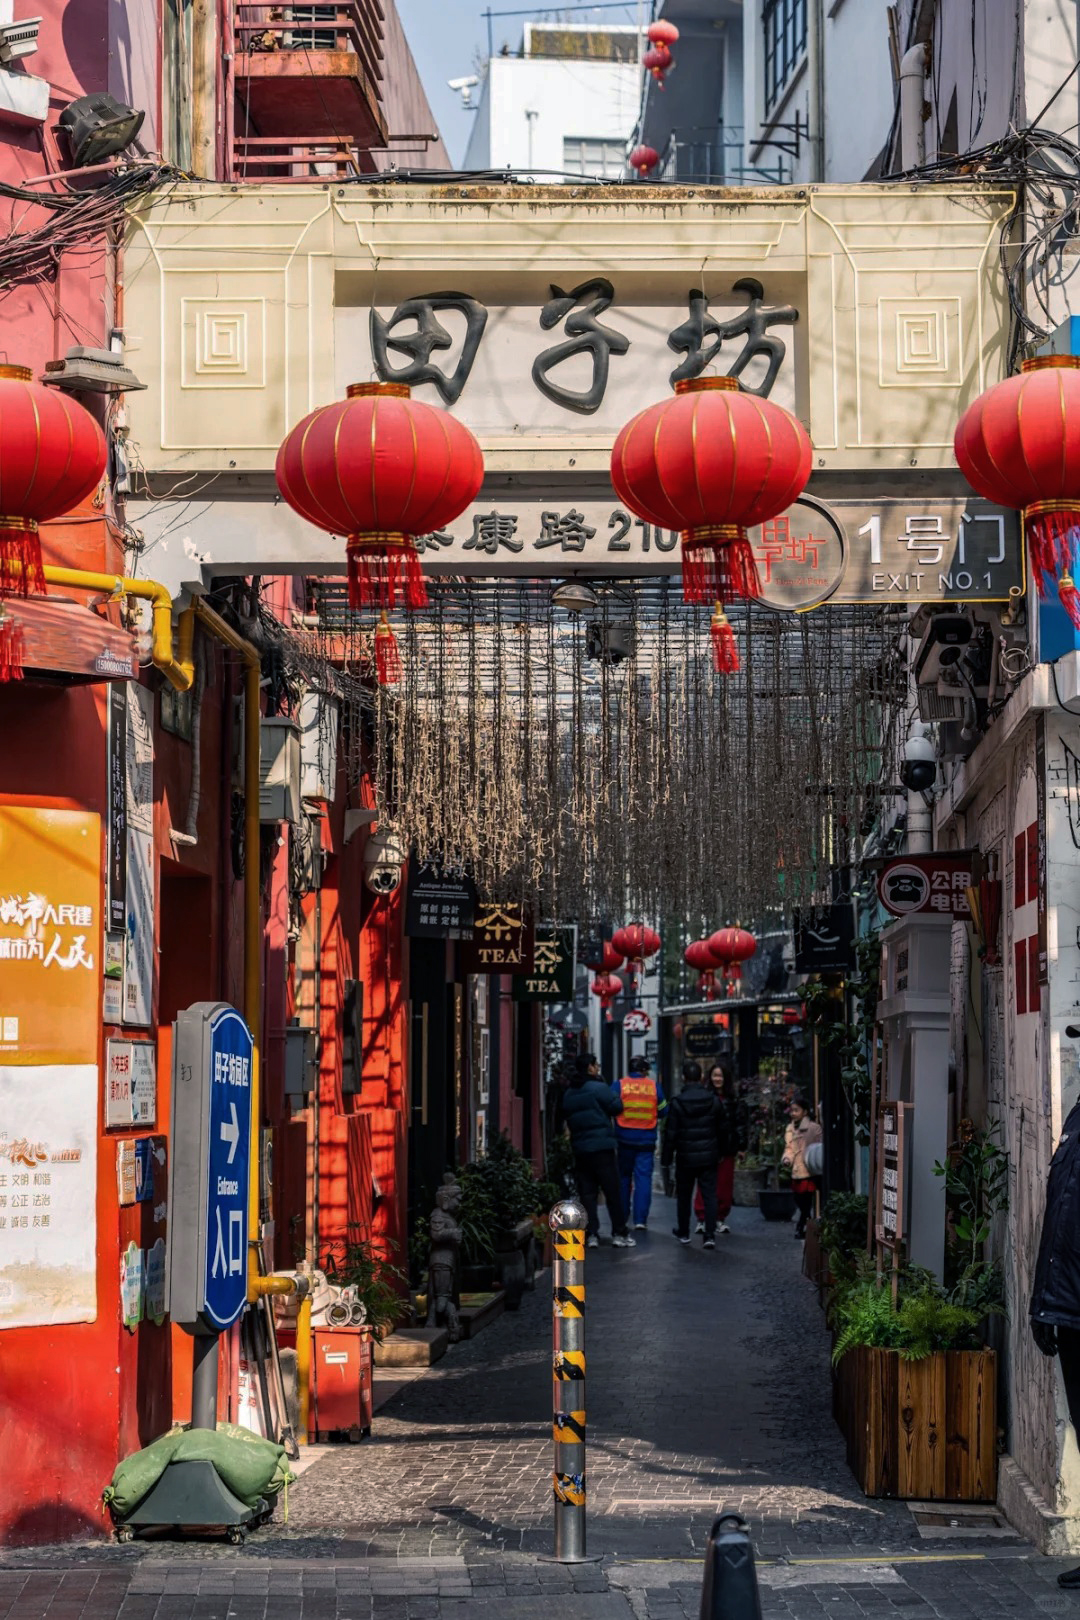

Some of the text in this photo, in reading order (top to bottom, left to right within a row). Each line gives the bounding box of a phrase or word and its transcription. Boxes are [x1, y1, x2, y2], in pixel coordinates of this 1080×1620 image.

[369, 277, 799, 415] 田子坊
[858, 512, 1006, 565] 1号门
[872, 571, 992, 591] EXIT NO.1
[931, 871, 971, 890] 公用
[930, 893, 971, 912] 电话
[478, 948, 520, 963] TEA
[526, 980, 560, 993] TEA
[214, 1052, 250, 1088] 田子坊园区
[12, 1174, 29, 1187] 文明
[33, 1173, 51, 1186] 和谐
[217, 1175, 239, 1197] Entrance
[12, 1194, 29, 1207] 公正
[33, 1194, 51, 1207] 法治
[11, 1216, 29, 1229] 诚信
[32, 1214, 50, 1228] 友善
[211, 1205, 244, 1280] 入口
